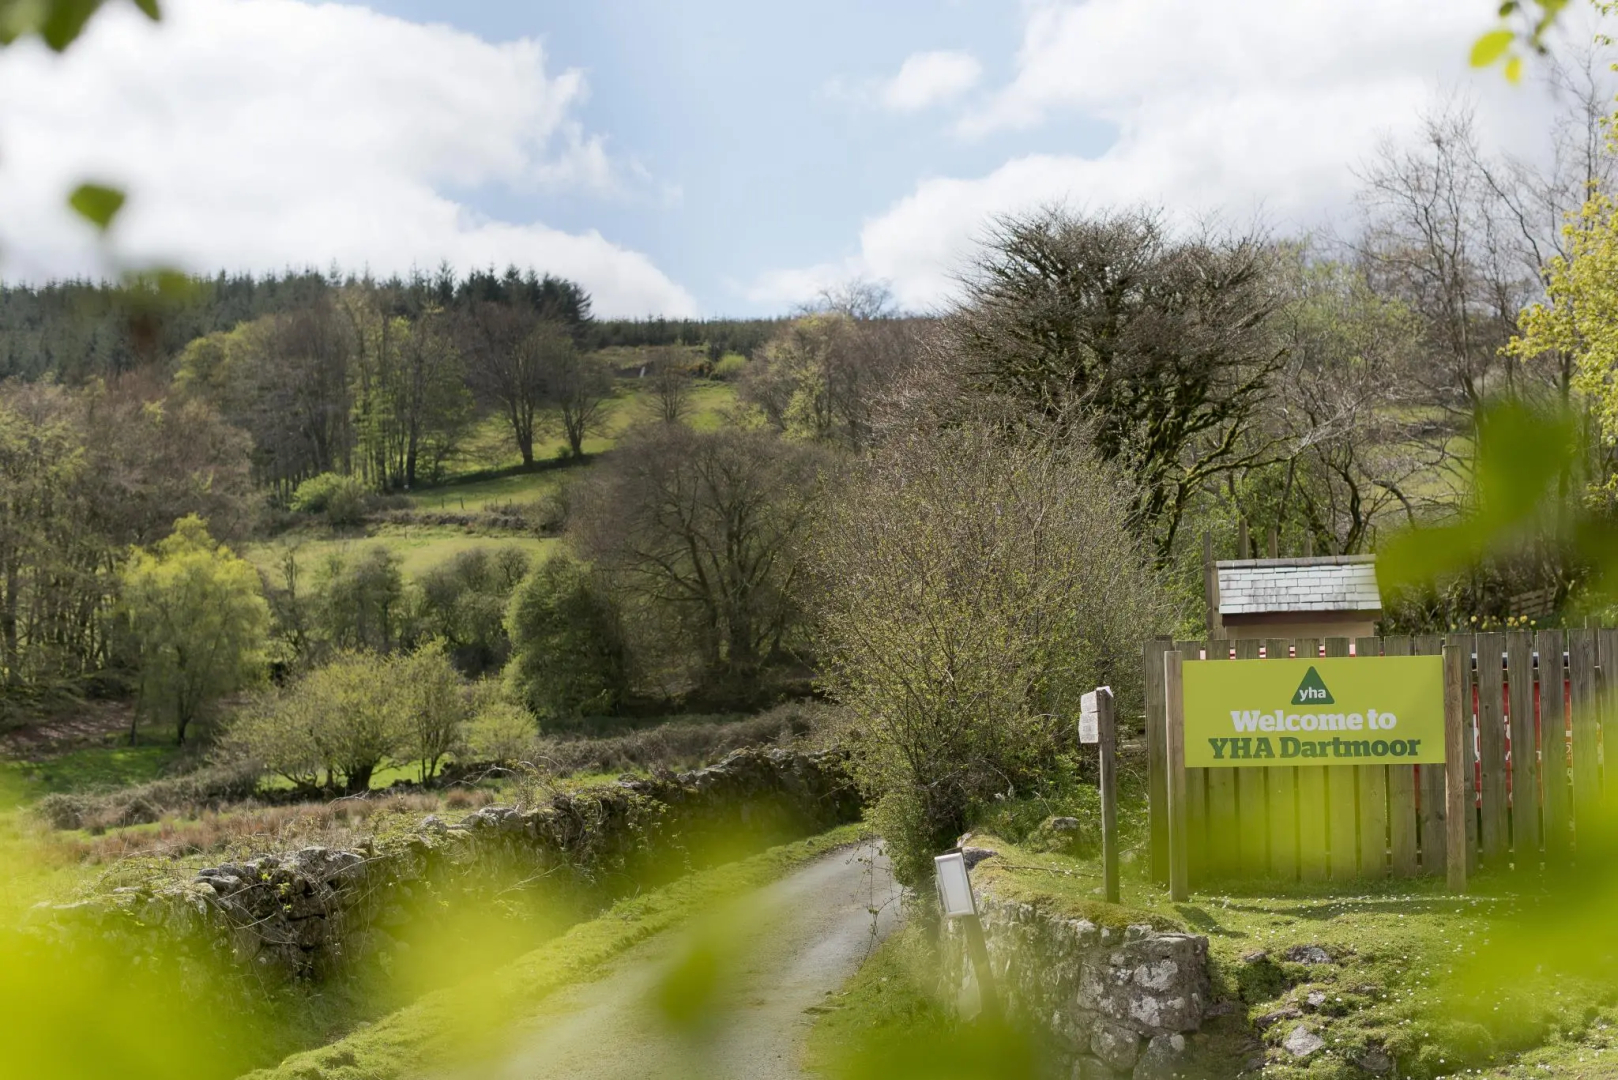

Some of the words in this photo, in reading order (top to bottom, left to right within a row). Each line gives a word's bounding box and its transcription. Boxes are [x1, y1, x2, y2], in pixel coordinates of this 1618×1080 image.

[1299, 687, 1327, 701] yha
[1230, 710, 1363, 732] Welcome
[1367, 709, 1397, 730] to
[1208, 737, 1276, 759] YHA
[1279, 736, 1421, 759] Dartmoor
